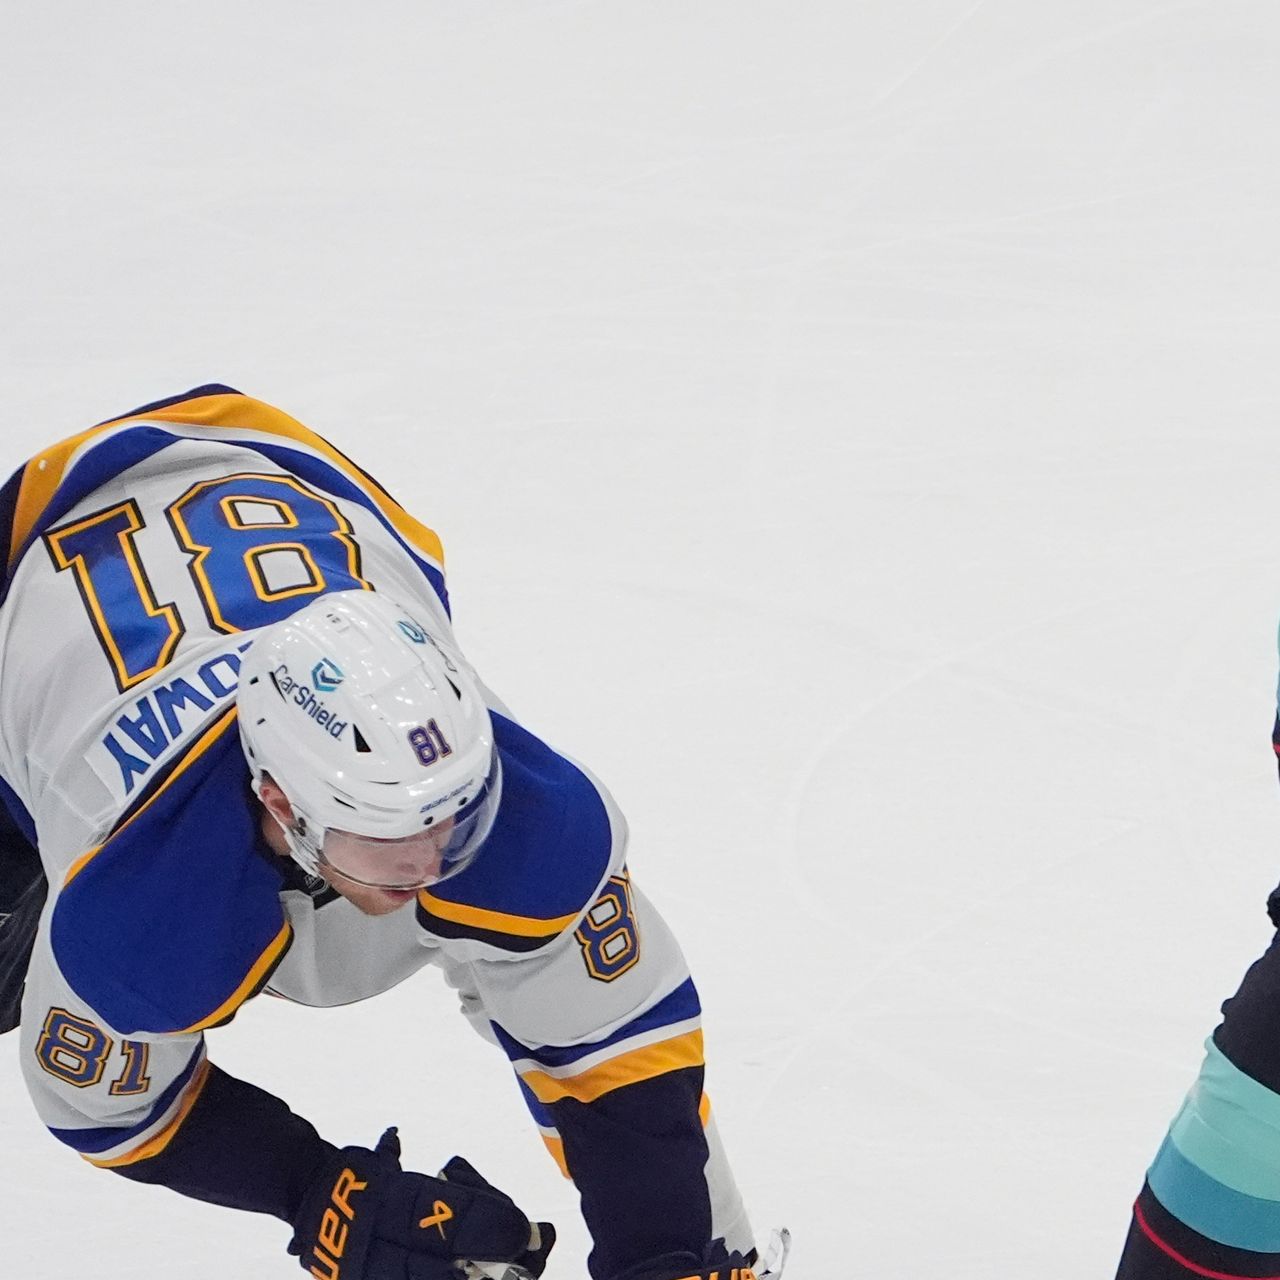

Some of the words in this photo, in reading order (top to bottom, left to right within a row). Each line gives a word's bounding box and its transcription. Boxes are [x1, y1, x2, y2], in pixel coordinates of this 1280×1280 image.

[42, 472, 376, 693] 81
[102, 641, 254, 797] OWAY
[272, 664, 348, 741] CarShield
[407, 717, 453, 767] 81
[573, 862, 640, 984] 8
[34, 1006, 152, 1096] 81
